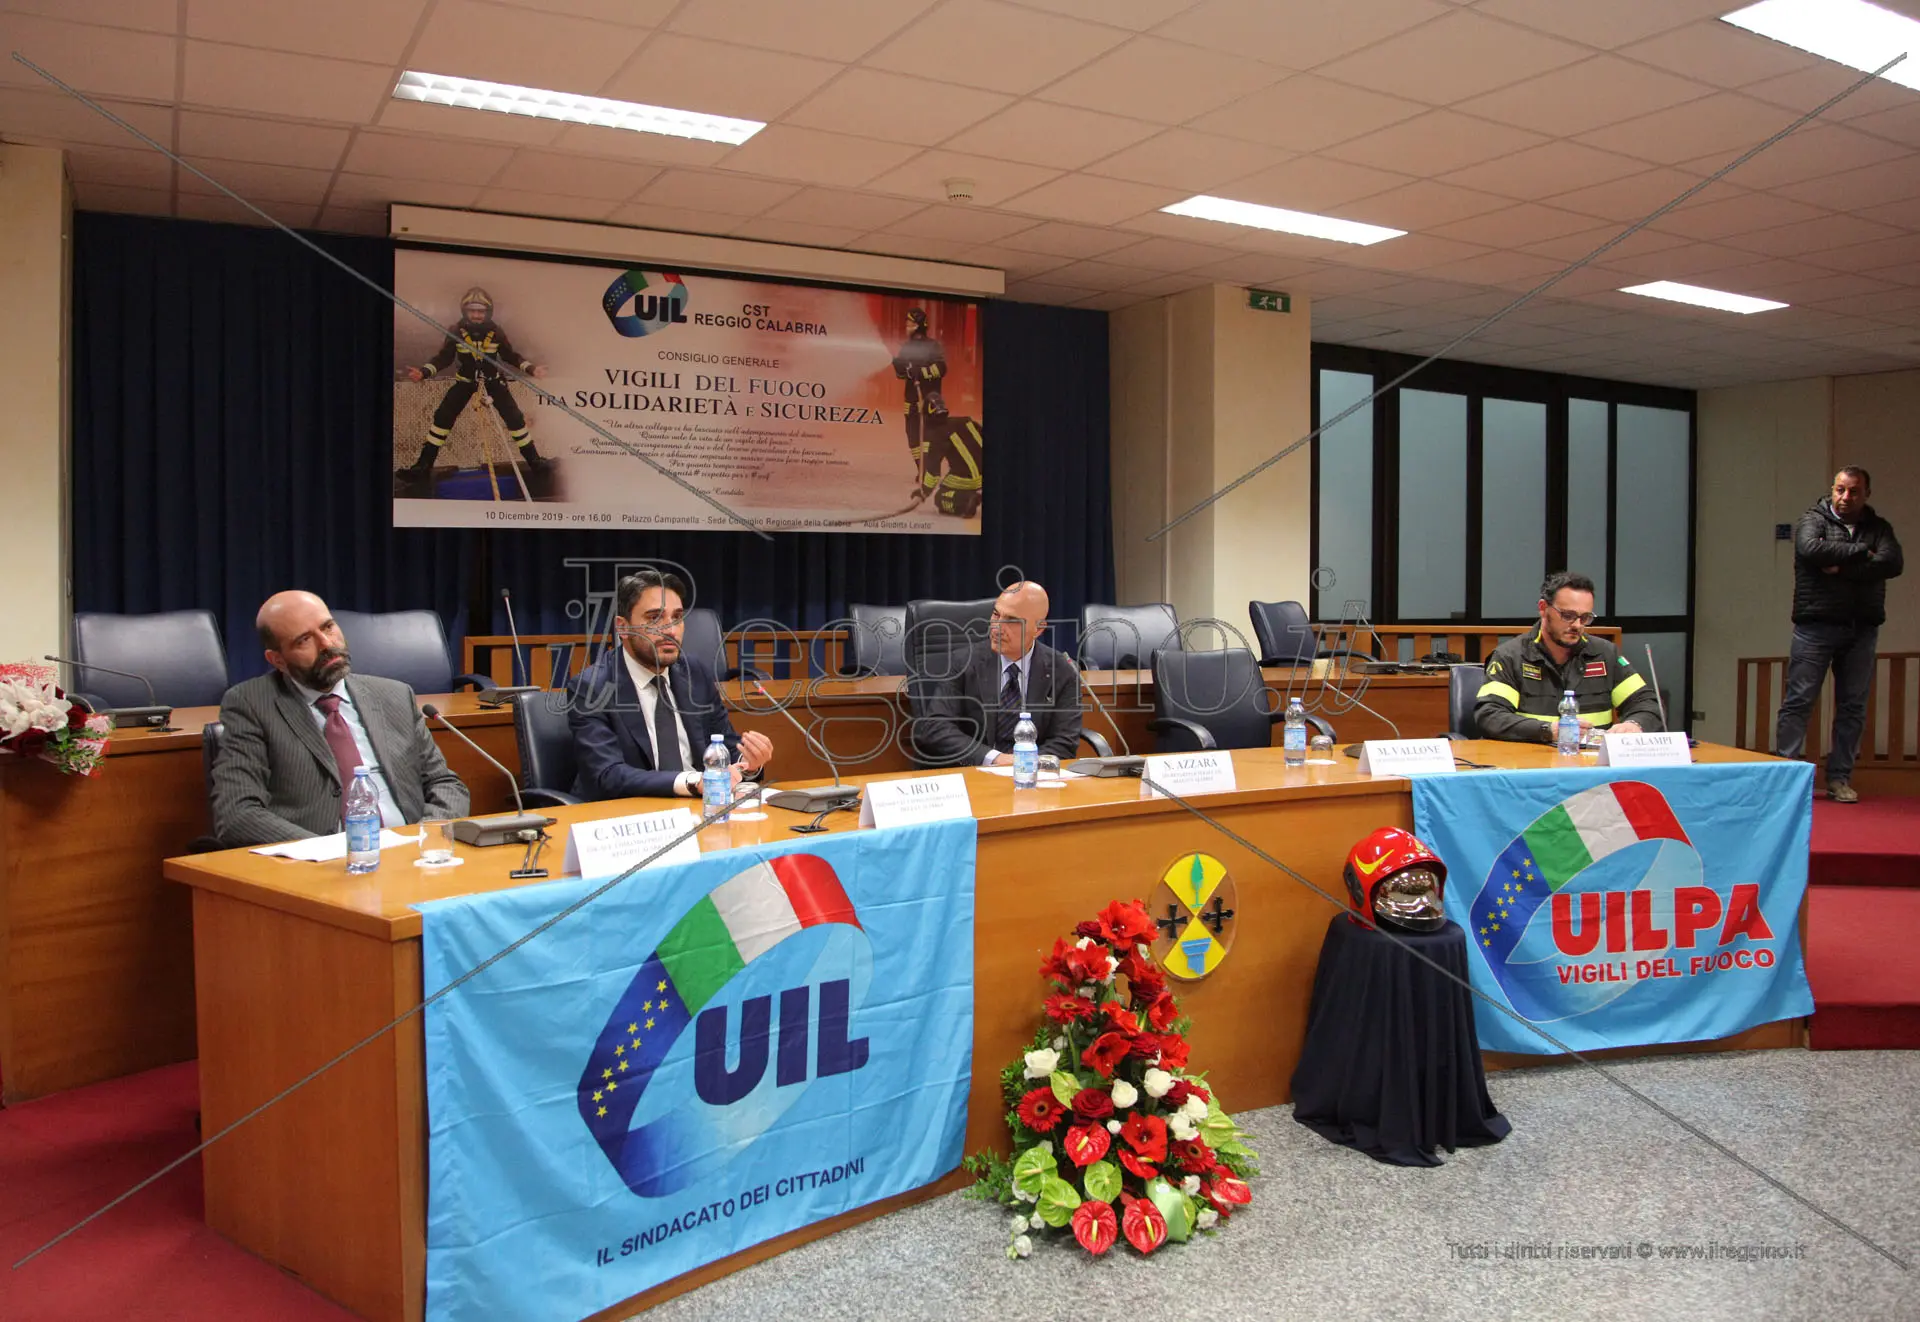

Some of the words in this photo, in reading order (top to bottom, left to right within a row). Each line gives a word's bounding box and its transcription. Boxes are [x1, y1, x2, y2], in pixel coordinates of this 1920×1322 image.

[634, 294, 688, 324] UIL
[742, 304, 771, 317] CST
[694, 313, 751, 329] REGGIO
[756, 319, 828, 336] CALABRIA
[658, 351, 719, 365] CONSIGLIO
[722, 355, 780, 369] GENERALE
[604, 369, 681, 389] VIGILI
[695, 375, 741, 394] DEL
[748, 378, 826, 399] FUOCO
[536, 394, 567, 407] TRA
[575, 391, 738, 416] SOLIDARIETÀ
[761, 402, 884, 425] SICUREZZA
[486, 511, 496, 519] 10
[498, 511, 540, 520] Dicembre
[542, 512, 563, 521] 2019
[589, 513, 611, 522] 16.00
[622, 514, 652, 523] Palazzo
[654, 515, 700, 524] Campanella
[707, 516, 726, 524] Sede
[766, 518, 801, 527] Regionale
[804, 518, 821, 526] della
[1391, 745, 1441, 755] VALLONE
[1635, 736, 1673, 745] ALAMPI
[910, 782, 940, 796] IRTO
[594, 828, 609, 841] C.
[611, 817, 676, 838] METELLI
[1551, 883, 1775, 957] UILPA
[1557, 961, 1627, 984] VIGILI
[1636, 958, 1682, 980] DEL
[1690, 948, 1776, 976] FUOCO
[694, 978, 870, 1106] UIL
[597, 1248, 614, 1267] IL
[620, 1198, 736, 1257] SINDACATO
[740, 1184, 769, 1211] DEI
[775, 1157, 865, 1197] CITTADINI
